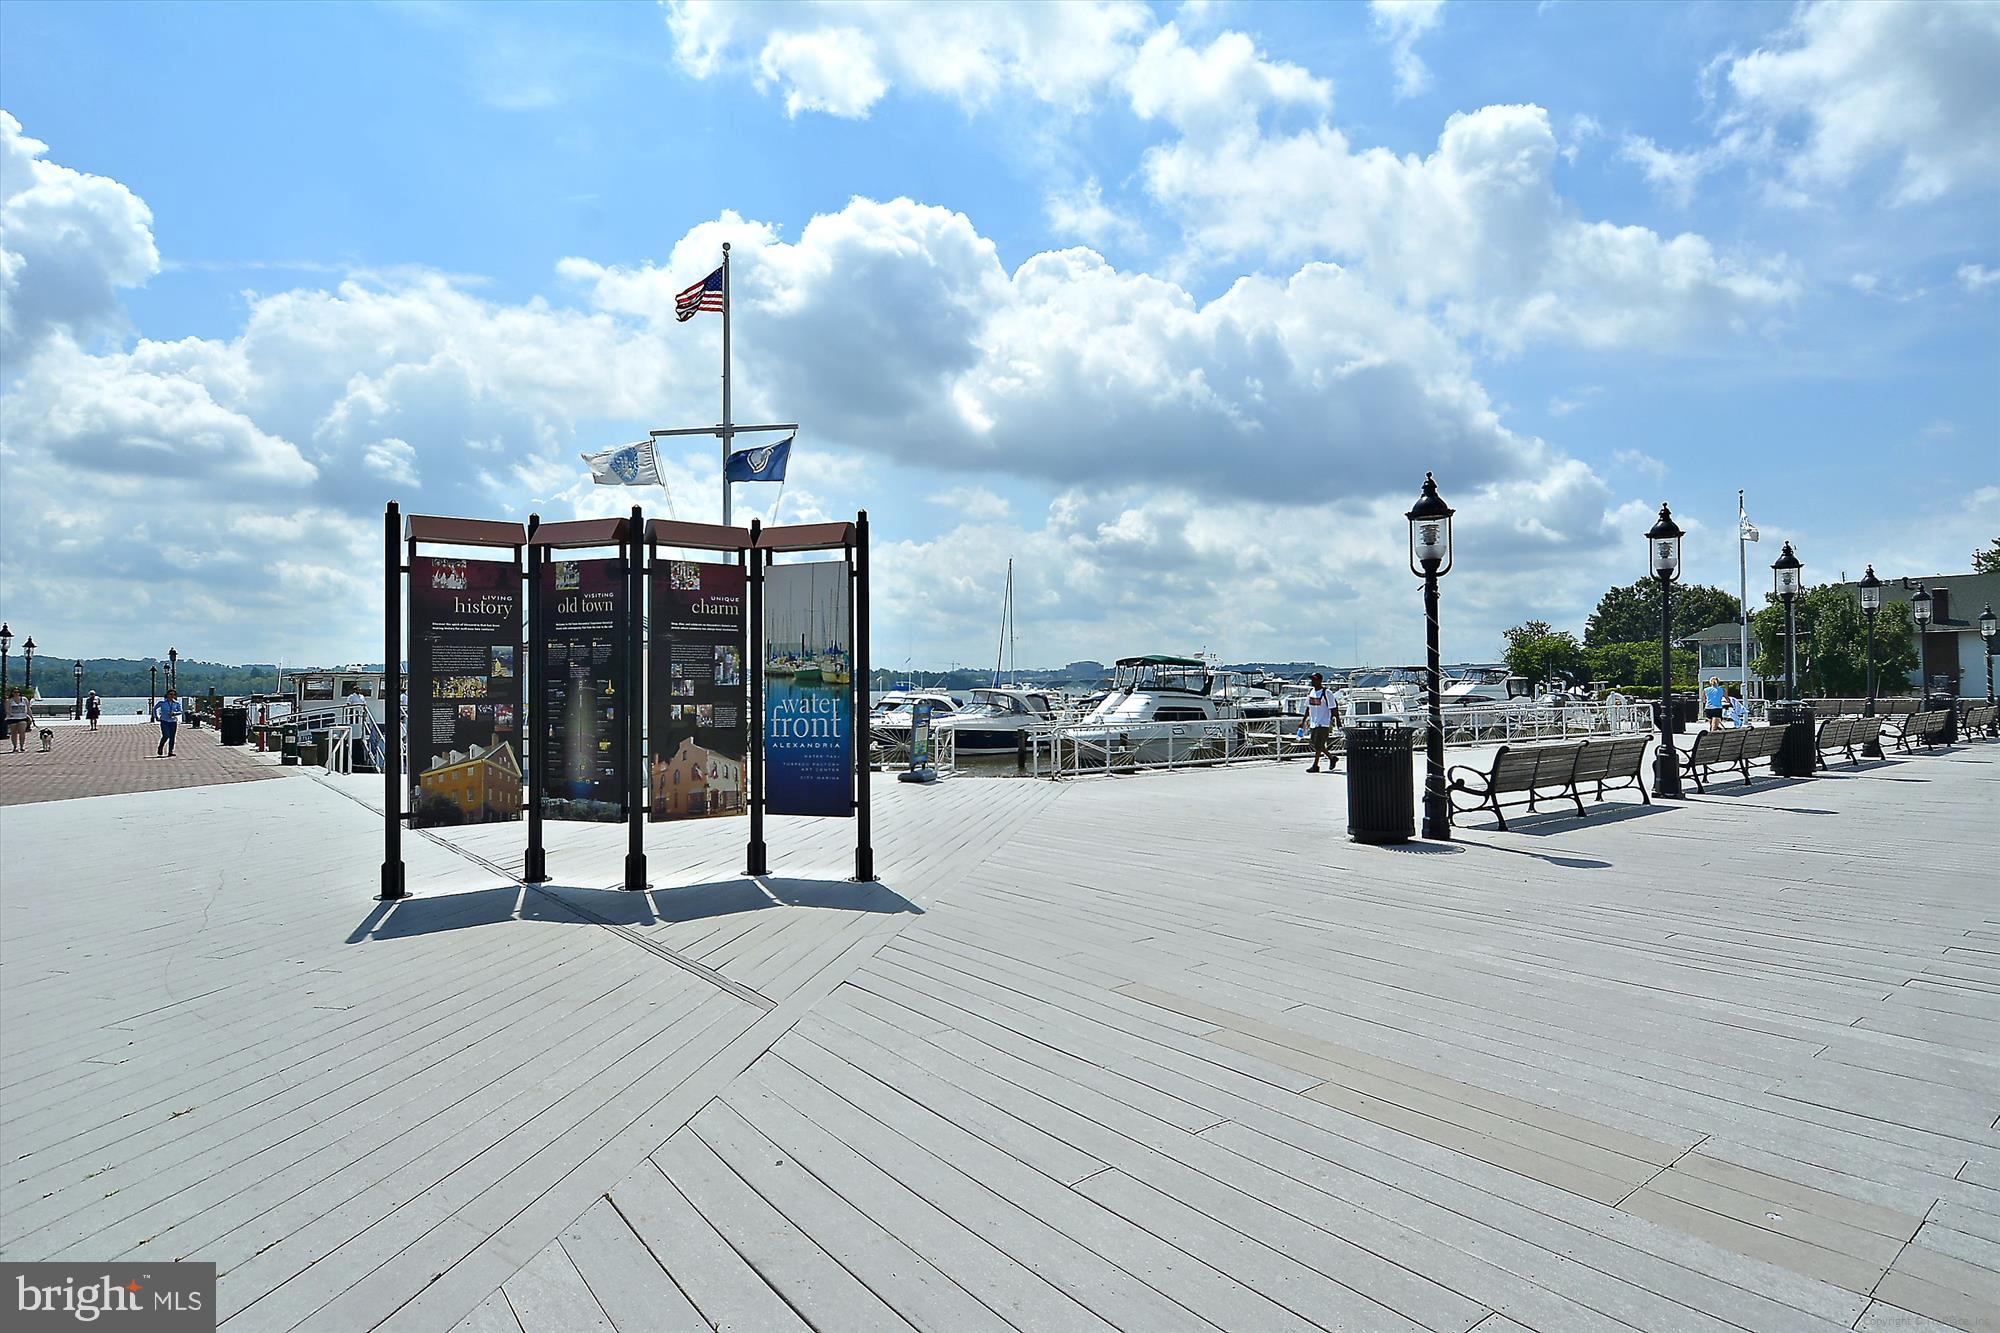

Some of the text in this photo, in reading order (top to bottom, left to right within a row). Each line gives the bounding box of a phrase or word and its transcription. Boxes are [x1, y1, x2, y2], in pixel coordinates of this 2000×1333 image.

[454, 596, 513, 619] history
[557, 596, 613, 613] old town
[691, 598, 739, 615] charm
[782, 693, 840, 714] water
[771, 705, 841, 738] front
